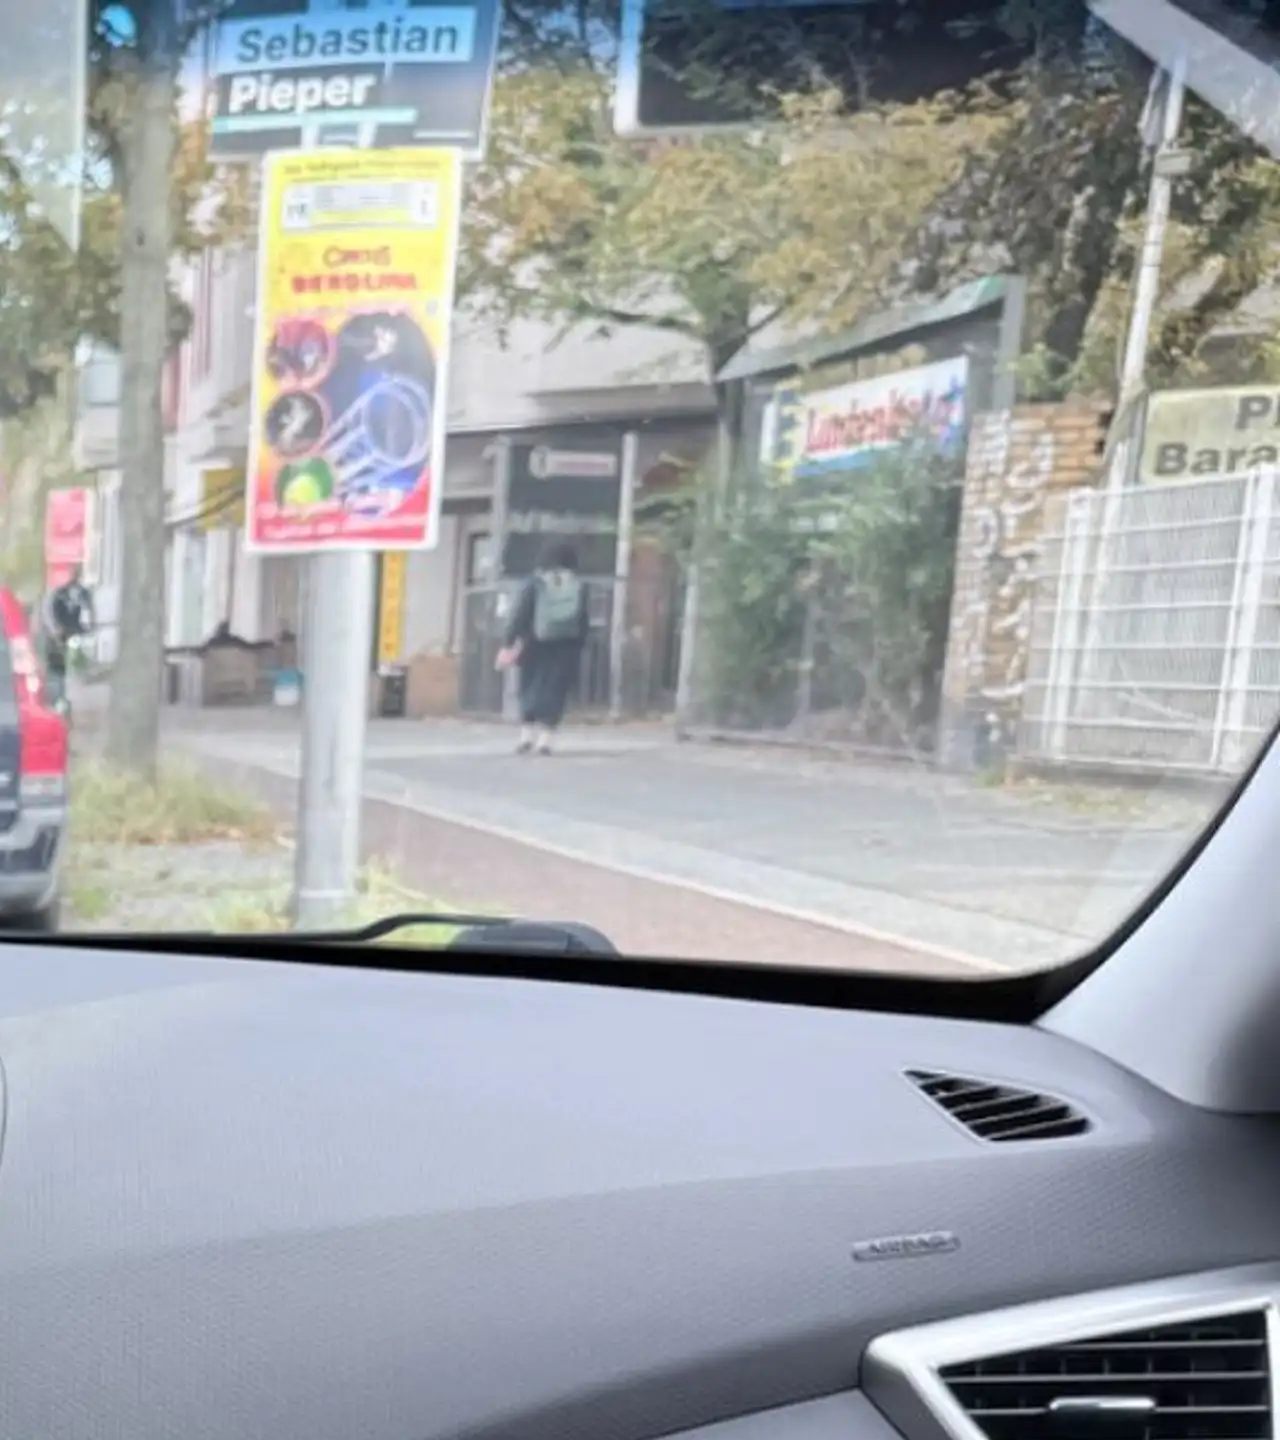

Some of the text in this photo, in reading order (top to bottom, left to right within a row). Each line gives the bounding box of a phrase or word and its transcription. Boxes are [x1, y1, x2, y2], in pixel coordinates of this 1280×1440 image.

[236, 16, 458, 63] Sebastian
[229, 73, 377, 115] Pieper
[1235, 394, 1280, 431] P
